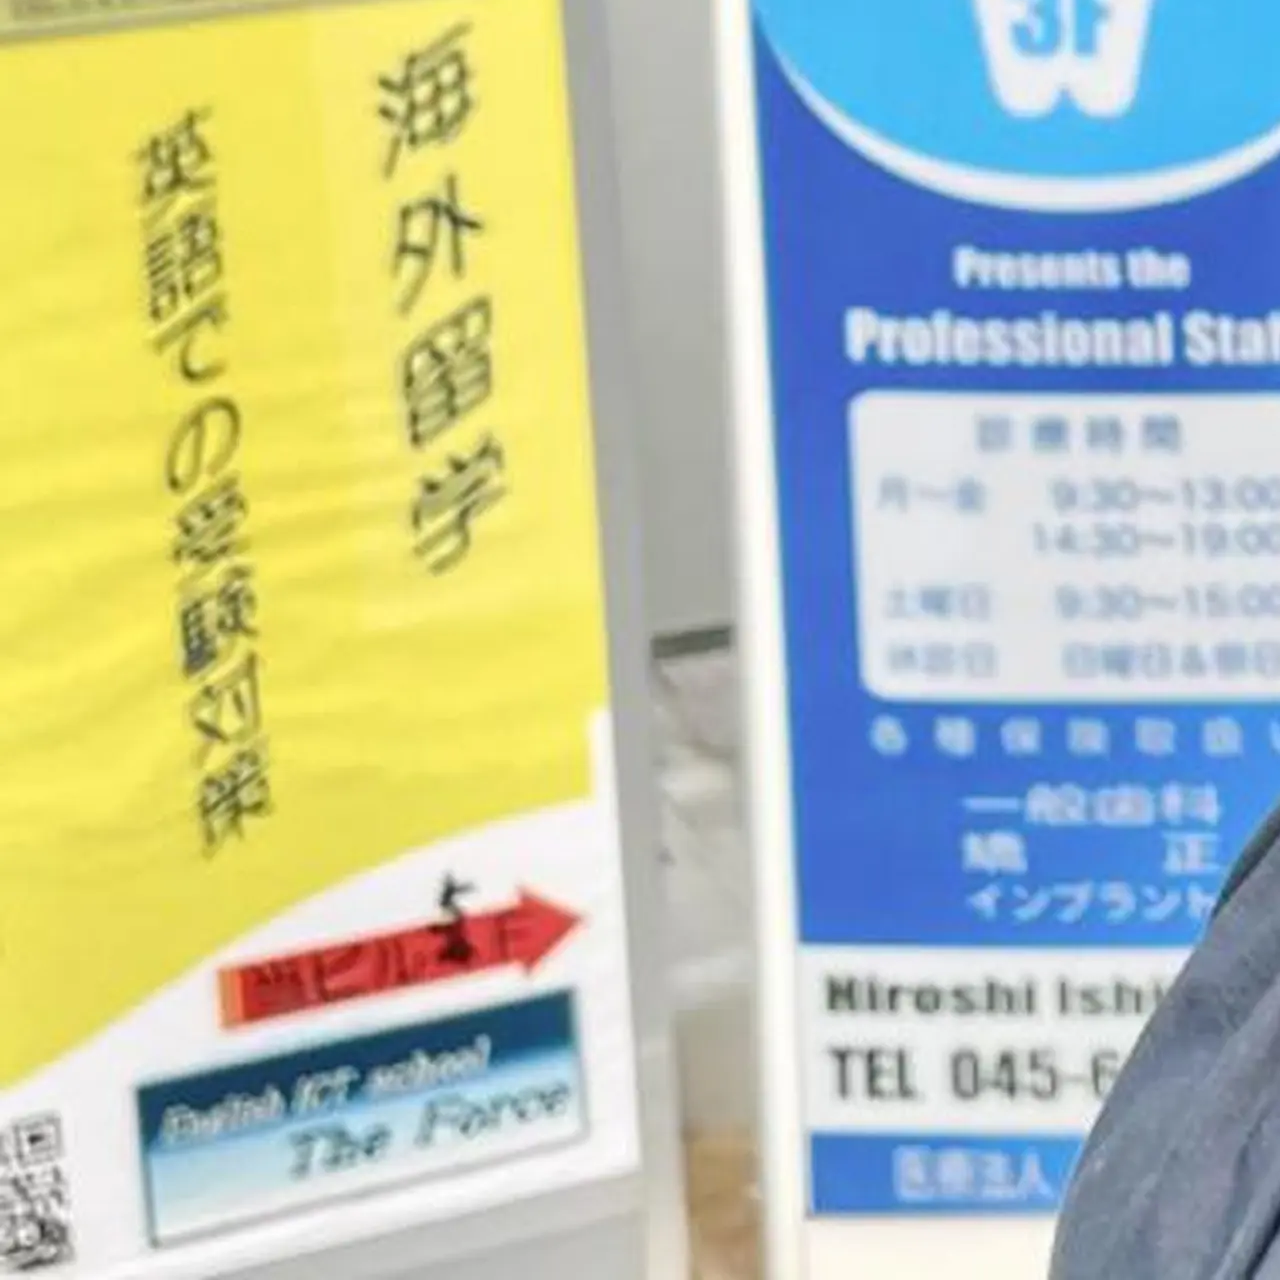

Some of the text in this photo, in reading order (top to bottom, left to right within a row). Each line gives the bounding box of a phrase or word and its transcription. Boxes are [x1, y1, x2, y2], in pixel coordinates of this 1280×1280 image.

[953, 247, 1191, 289] Presents the
[376, 22, 506, 576] 海外留学
[846, 307, 1173, 365] Professional
[826, 975, 1036, 1015] Hiroshi
[828, 1048, 916, 1100] TEL
[290, 1081, 569, 1177] The Force
